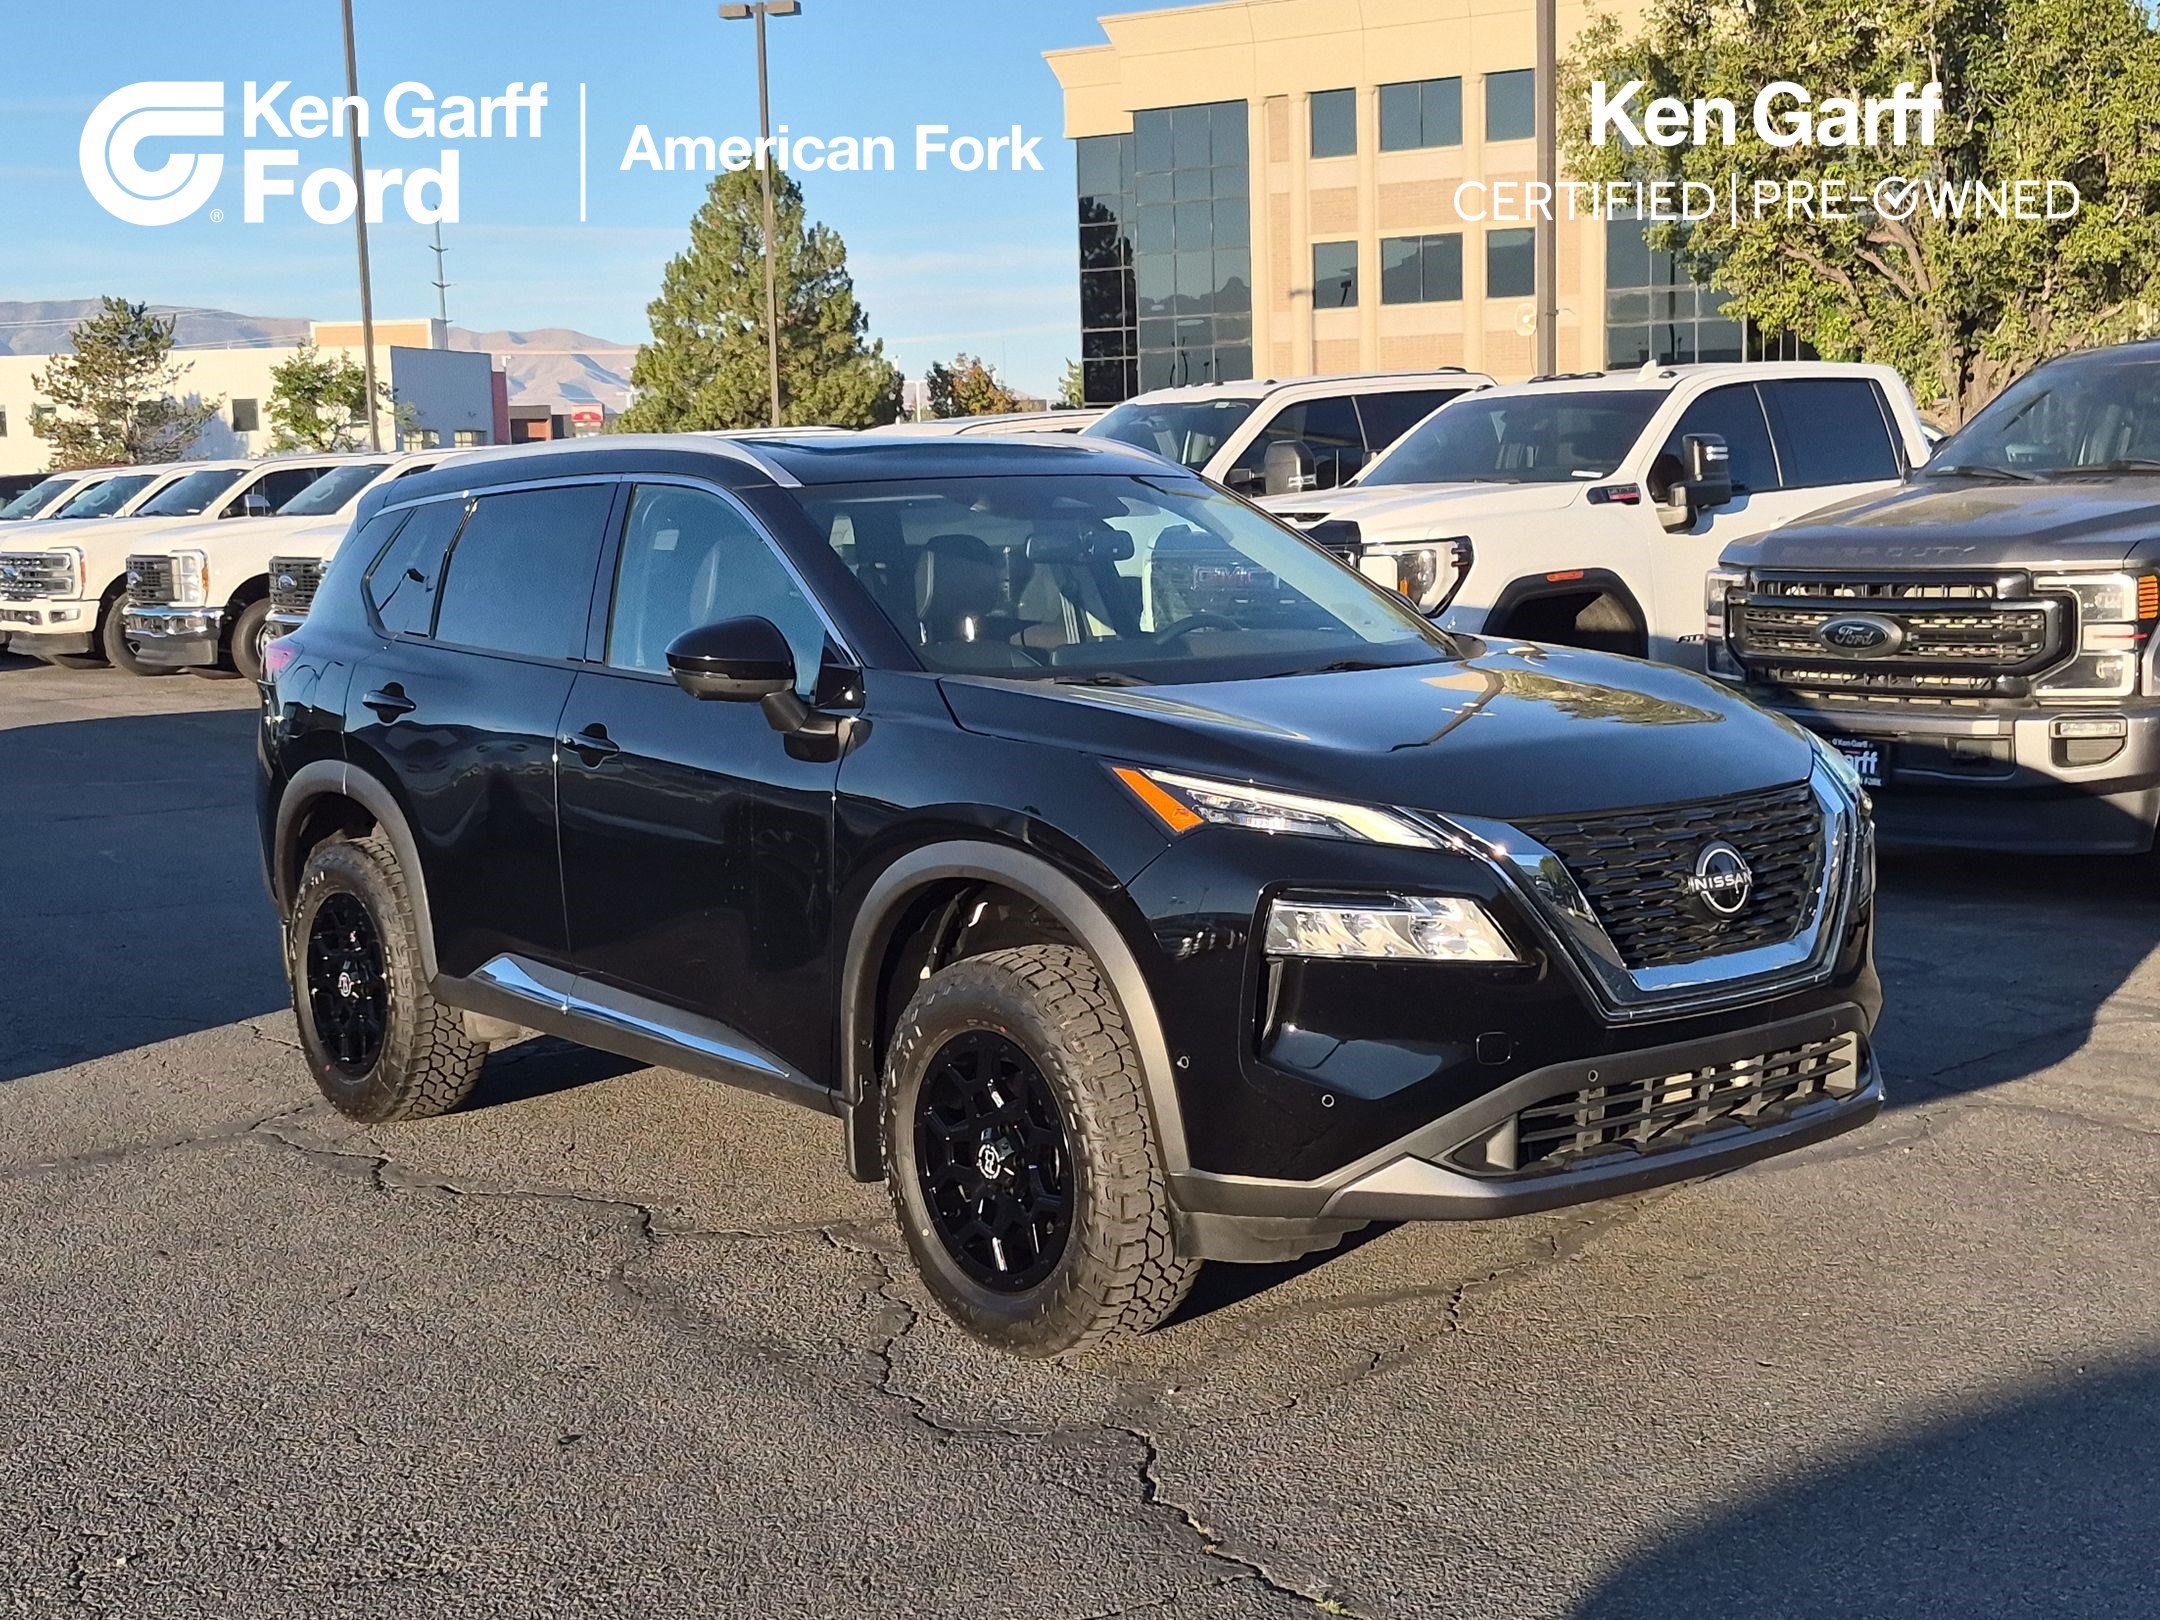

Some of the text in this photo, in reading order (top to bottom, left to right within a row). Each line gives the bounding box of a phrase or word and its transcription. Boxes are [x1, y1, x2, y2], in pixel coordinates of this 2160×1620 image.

[1834, 624, 1875, 646] Ford
[1844, 750, 1878, 775] arff
[1693, 871, 1753, 891] NISSAN
